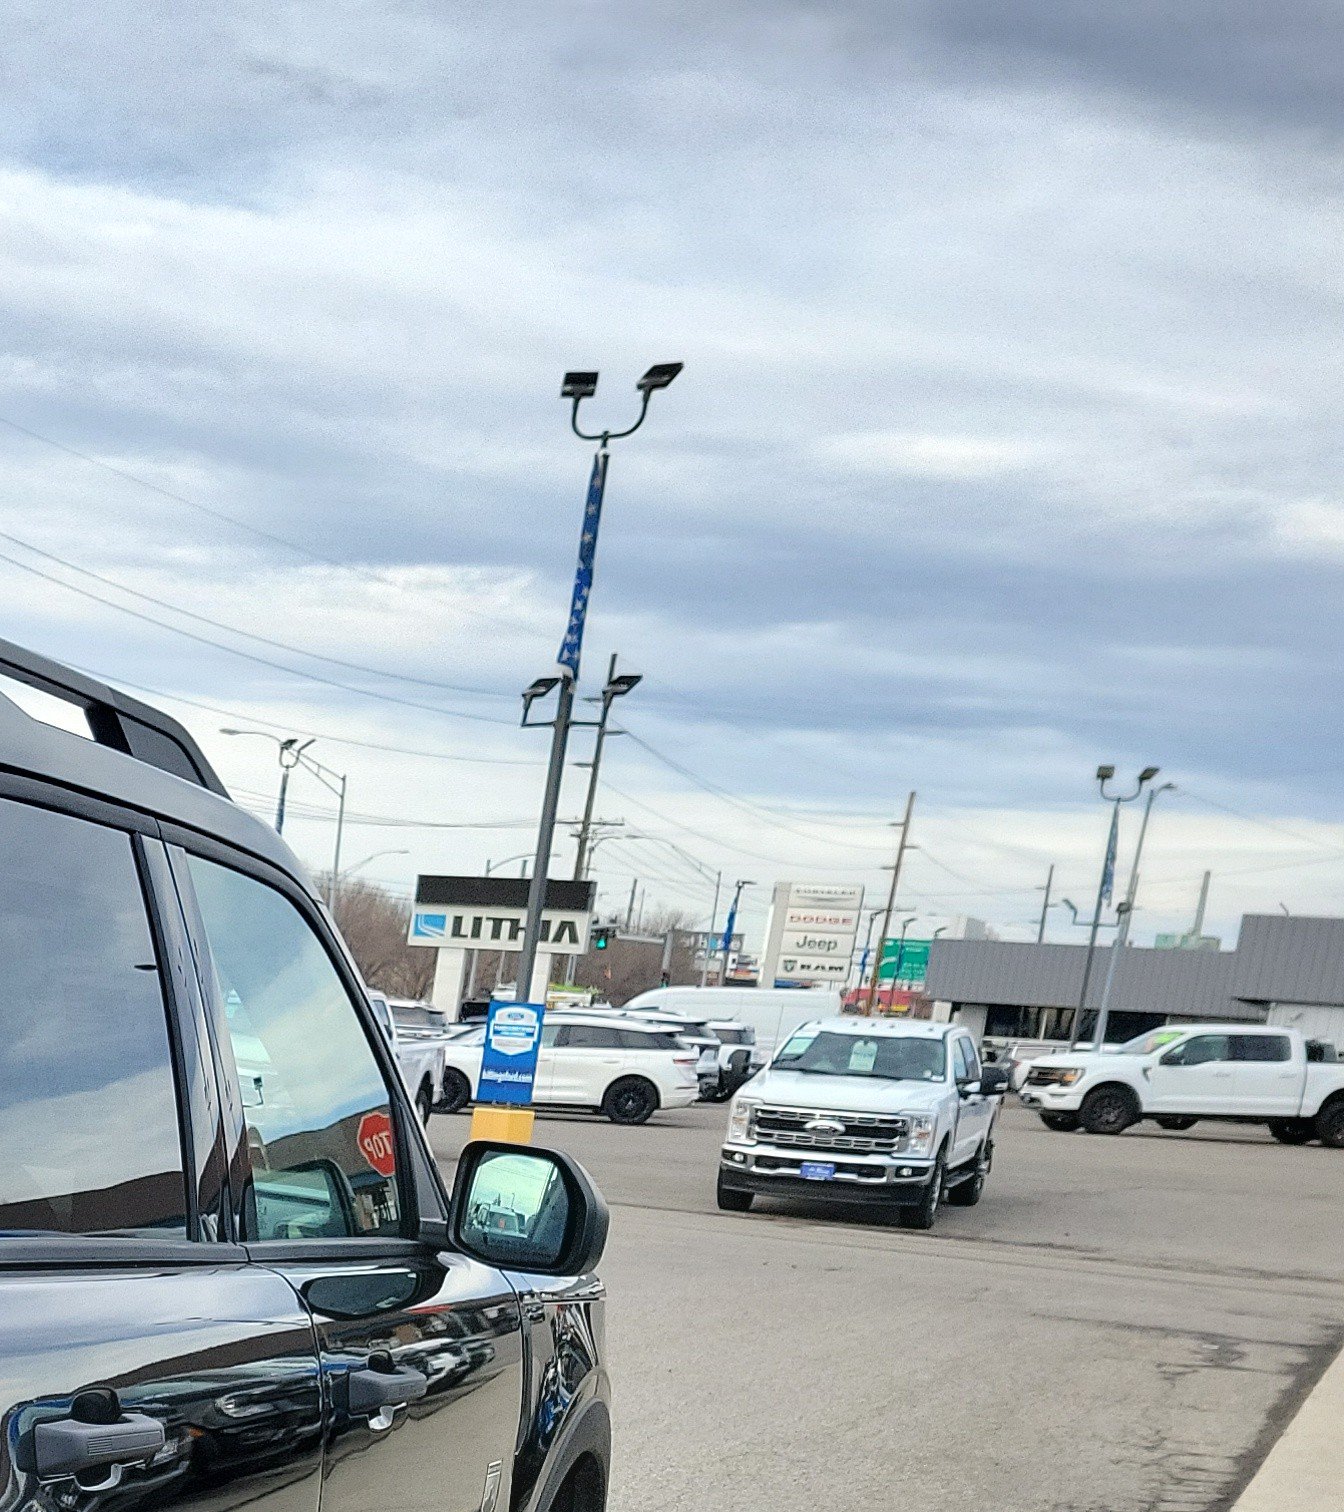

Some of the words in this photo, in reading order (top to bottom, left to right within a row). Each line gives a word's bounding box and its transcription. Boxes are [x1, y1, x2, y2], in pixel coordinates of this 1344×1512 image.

[790, 915, 853, 925] DODGE
[796, 935, 838, 951] Jeep
[800, 964, 844, 972] RAM
